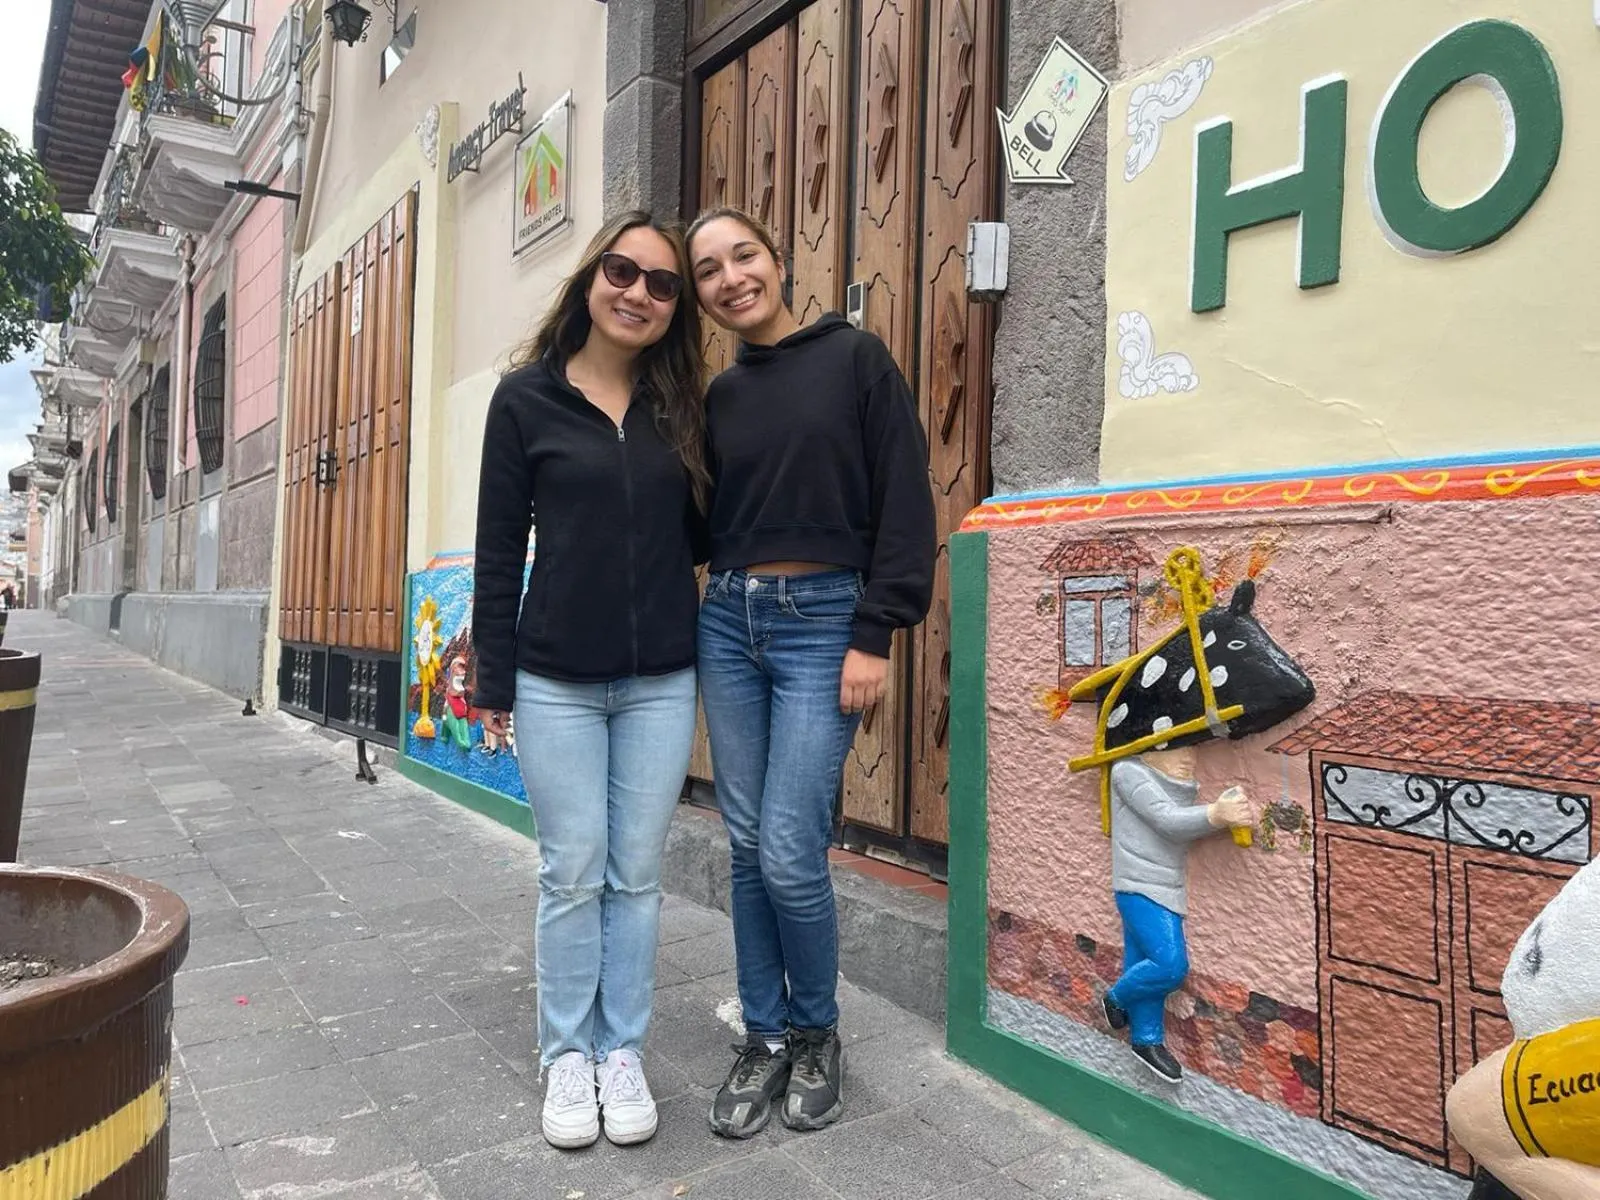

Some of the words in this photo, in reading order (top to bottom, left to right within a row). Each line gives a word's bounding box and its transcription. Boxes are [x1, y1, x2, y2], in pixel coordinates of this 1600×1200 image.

[1010, 135, 1043, 175] BELL
[1190, 14, 1600, 314] HO
[518, 216, 542, 240] FRIENDS
[543, 203, 562, 224] HOTEL
[1528, 1072, 1600, 1105] Ecua
